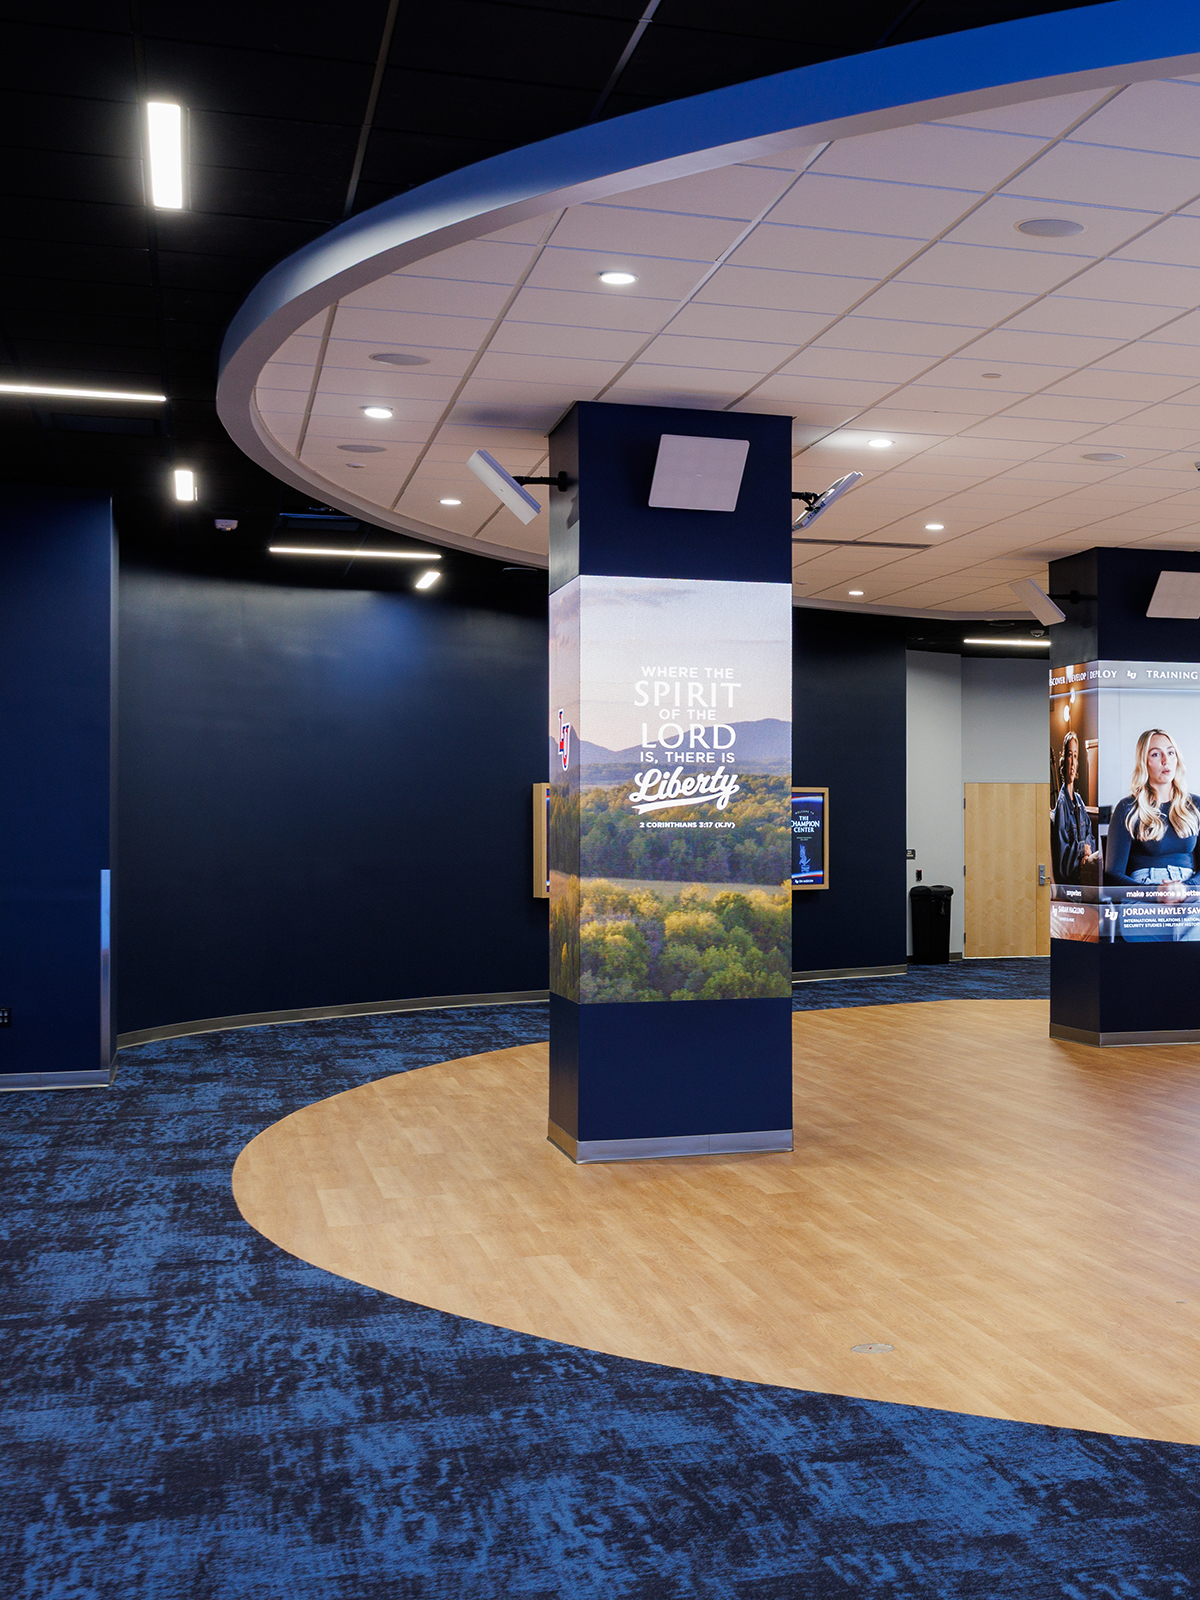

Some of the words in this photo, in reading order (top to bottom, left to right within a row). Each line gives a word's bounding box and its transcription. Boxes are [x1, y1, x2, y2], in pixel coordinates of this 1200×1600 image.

[641, 666, 698, 678] WHERE
[705, 667, 734, 679] THE
[1068, 672, 1087, 683] DEVELOP
[1090, 670, 1118, 679] DEPLOY
[1146, 670, 1198, 680] TRAINING
[634, 680, 741, 708] SPIRIT
[659, 708, 680, 720] OF
[686, 709, 717, 720] THE
[642, 722, 736, 749] LORD
[640, 752, 658, 764] IS,
[665, 752, 715, 763] THERE
[722, 752, 735, 763] IS
[629, 766, 740, 811] Liberty
[1122, 908, 1156, 917] JORDAN
[1157, 907, 1187, 915] HAYLEY
